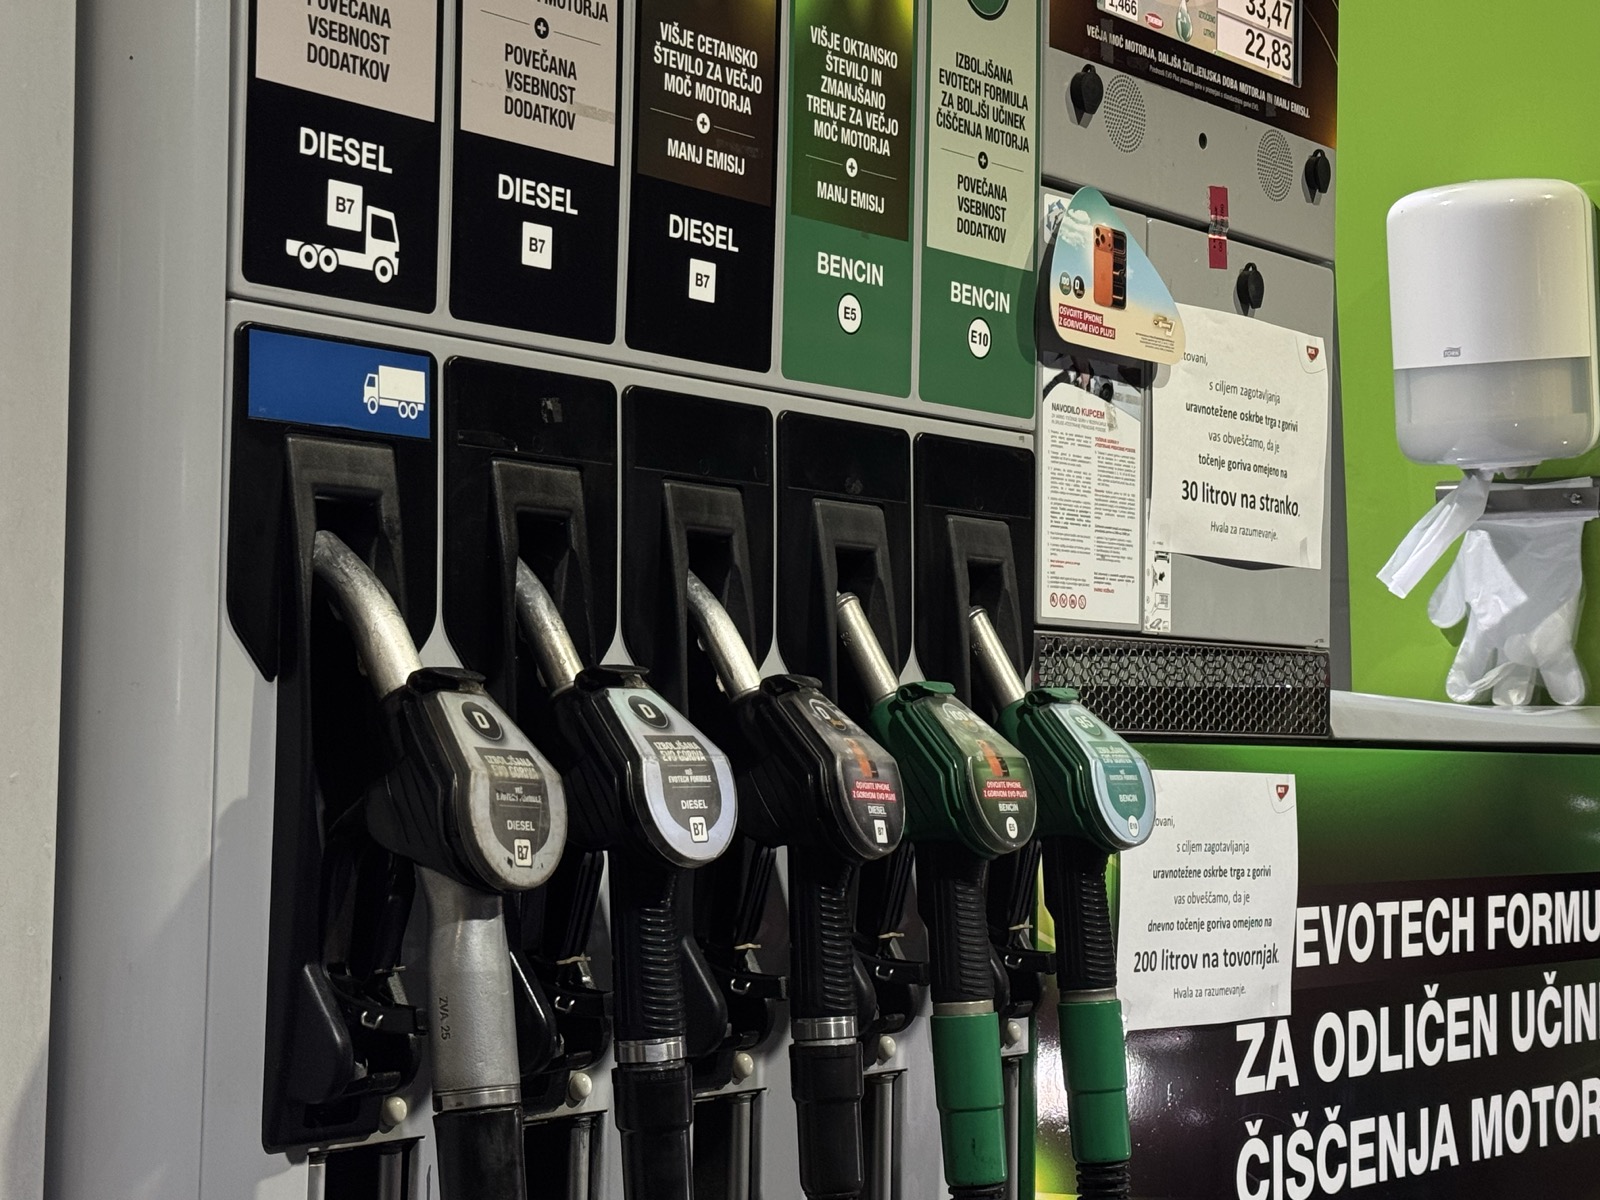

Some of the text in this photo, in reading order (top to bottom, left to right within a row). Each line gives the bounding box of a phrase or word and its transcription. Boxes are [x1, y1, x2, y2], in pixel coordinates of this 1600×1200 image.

[1246, 0, 1292, 30] 33,47
[308, 14, 390, 55] VSEBNOST
[660, 21, 758, 69] VIŠJE CETANSKO
[810, 25, 898, 69] VIŠJE OKTANSKO
[1245, 28, 1292, 71] 22,83
[307, 42, 390, 83] DODATKOV
[505, 43, 577, 80] POVEČANA
[654, 41, 763, 94] ŠTEVILO ZA VEČJO
[826, 50, 882, 87] ŠTEVILO IN
[956, 51, 1013, 85] IZBOLJŠANA
[1086, 24, 1108, 42] VEČJA
[1108, 33, 1124, 48] MOČ
[1124, 38, 1157, 62] MOTORJA,
[1158, 51, 1182, 70] DALJŠA
[1182, 58, 1221, 85] ŽIVLJENJSKA
[1222, 75, 1238, 92] DOBA
[1239, 81, 1266, 102] MOTORJA
[1274, 95, 1290, 111] MANJ
[505, 69, 576, 105] VSEBNOST
[664, 72, 751, 115] MOČ MOTORJA
[821, 75, 886, 110] ZMANJŠANO
[939, 67, 1029, 111] EVOTECH FORMULA
[504, 95, 576, 131] DODATKOV
[806, 94, 899, 136] TRENJE ZA VEČJO
[941, 90, 1026, 131] ZA BOLJŠI UČINEK
[814, 119, 891, 157] MOČ MOTORJA
[936, 107, 1030, 153] ČIŠČENJA MOTORJA
[299, 126, 393, 174] DIESEL
[668, 138, 745, 176] MANJ EMISIJ
[498, 173, 578, 215] DIESEL
[817, 180, 885, 215] MANJ EMISIJ
[957, 174, 1008, 203] POVEČANA
[336, 196, 355, 215] B7
[957, 194, 1007, 223] VSEBNOST
[529, 237, 546, 254] B7
[669, 214, 739, 252] DIESEL
[957, 217, 1007, 244] DODATKOV
[695, 273, 710, 289] B7
[817, 252, 884, 287] BENCIN
[950, 281, 1011, 315] BENCIN
[844, 306, 857, 321] E5
[970, 329, 989, 347] E10
[1089, 324, 1099, 334] EVO
[1100, 328, 1115, 338] PLUS!
[1184, 351, 1208, 366] tovani,
[1209, 380, 1281, 406] s ciljem zagotavljanja
[1052, 402, 1105, 419] NAVODILO KUPCEM
[1186, 402, 1298, 432] uravnotežene oskrbe trga z gorivi
[1208, 432, 1280, 455] vas obveščamo, da je
[1198, 453, 1288, 479] točenje goriva omejeno na
[1182, 479, 1300, 517] 30 litrov na stranko.
[1210, 521, 1279, 542] Hvala za razumevanje.
[472, 711, 490, 729] D
[638, 704, 656, 718] D
[660, 750, 678, 761] EVO
[668, 775, 689, 783] EVOTECH
[681, 800, 708, 810] DIESEL
[1119, 794, 1138, 802] BENCIN
[507, 820, 535, 831] DIESEL
[693, 823, 704, 836] B7
[518, 845, 529, 860] B7
[1176, 840, 1250, 855] s ciljem zagotavljanja
[1153, 865, 1272, 880] uravnotežene oskrbe trga z gorivi
[1174, 891, 1250, 905] vas obveščamo, da je
[1148, 916, 1273, 932] dnevno točenje goriva omejeno na
[1296, 889, 1600, 968] EVOTECH FORMU
[1134, 942, 1280, 973] 200 litrov na tovornjak.
[1174, 983, 1246, 999] Hvala za razumevanje.
[440, 1025, 451, 1041] 25
[1235, 970, 1600, 1096] ZA ODLIČEN UČIN
[1236, 1077, 1600, 1200] ČIŠČENJA MOTOR
